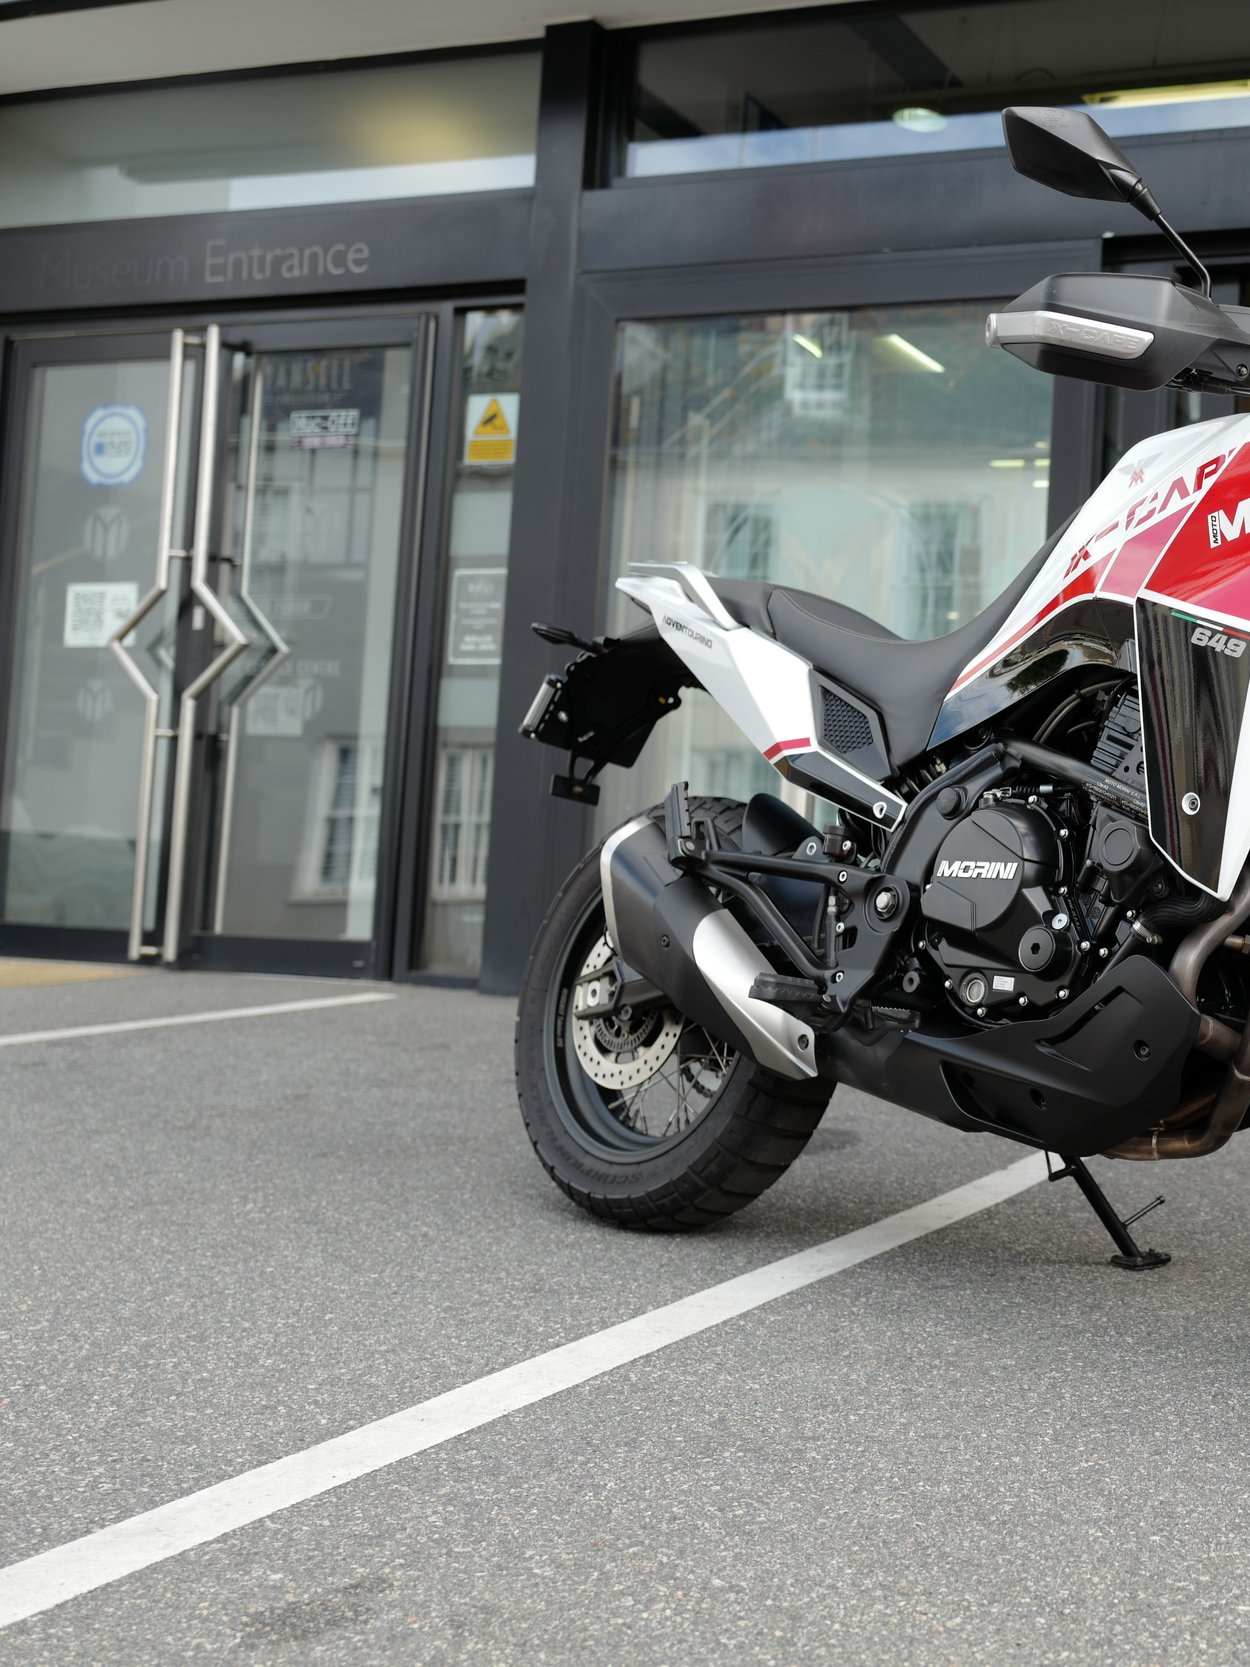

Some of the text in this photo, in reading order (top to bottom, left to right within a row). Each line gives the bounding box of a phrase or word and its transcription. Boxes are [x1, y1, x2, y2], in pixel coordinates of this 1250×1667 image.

[39, 238, 371, 293] Museum Entrance
[1063, 447, 1236, 580] X-CAP
[1211, 515, 1219, 544] MOTO
[1190, 627, 1247, 658] 649
[939, 860, 1019, 880] MORINI
